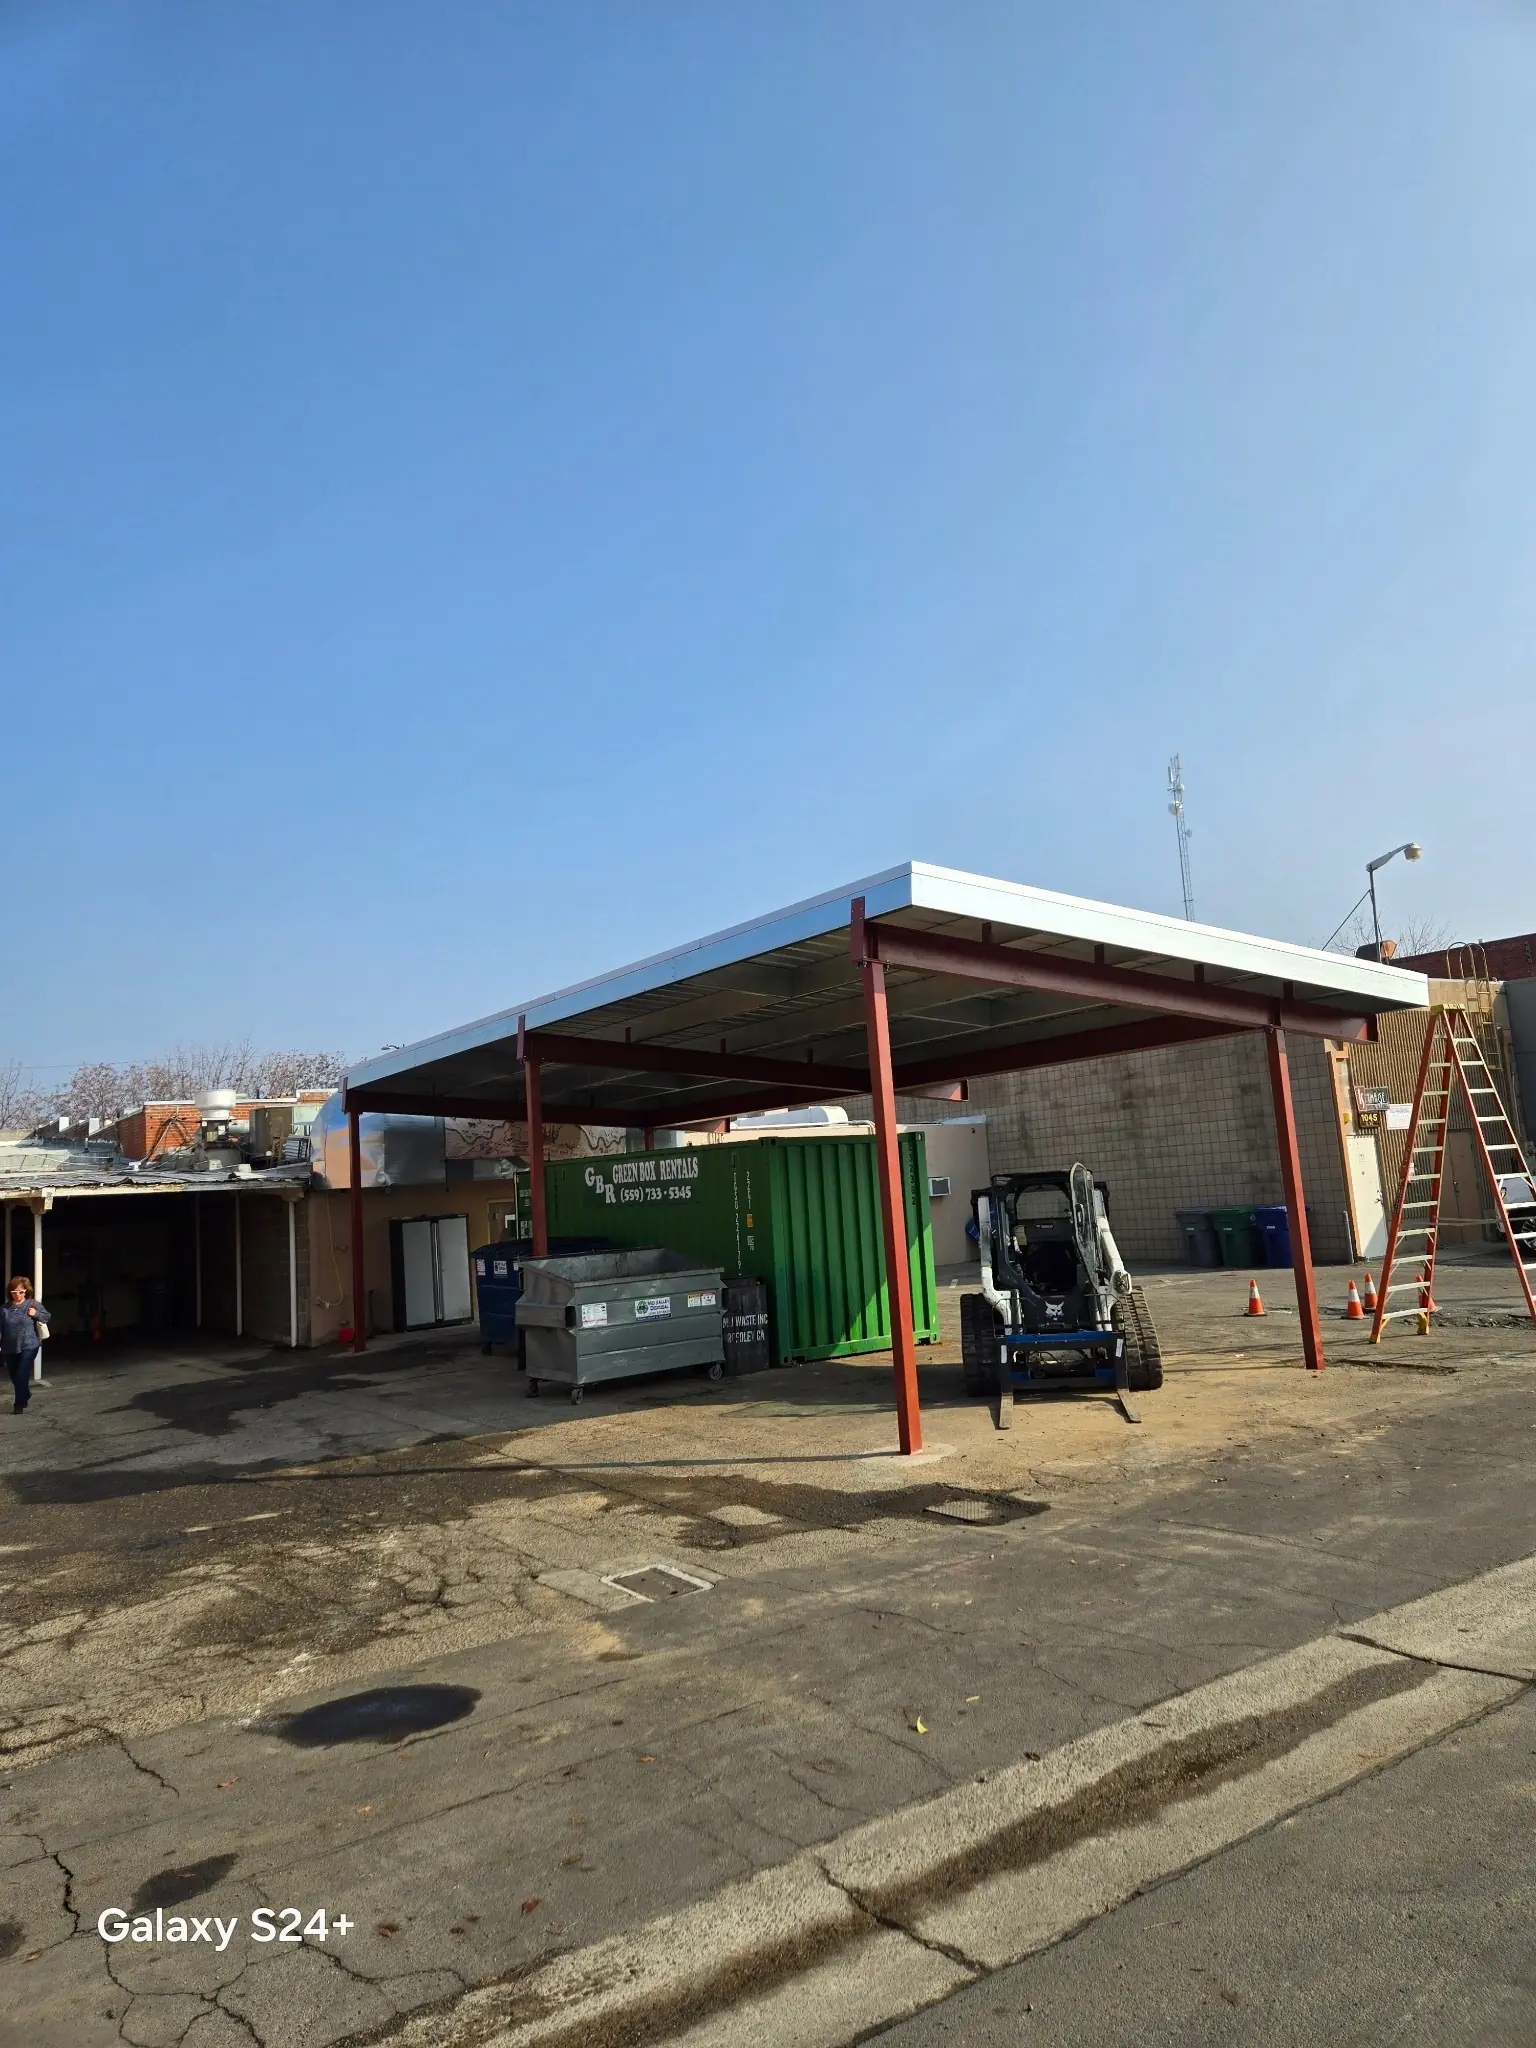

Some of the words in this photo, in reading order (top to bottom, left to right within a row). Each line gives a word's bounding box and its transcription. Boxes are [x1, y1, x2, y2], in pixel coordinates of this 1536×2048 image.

[1360, 1113, 1378, 1122] 1045
[612, 1162, 638, 1183] GREEN
[639, 1160, 657, 1182] BOX
[660, 1157, 699, 1180] RENTALS
[620, 1186, 644, 1203] (559)
[735, 1314, 757, 1327] WASTE
[757, 1313, 768, 1325] INC
[756, 1329, 765, 1341] CA
